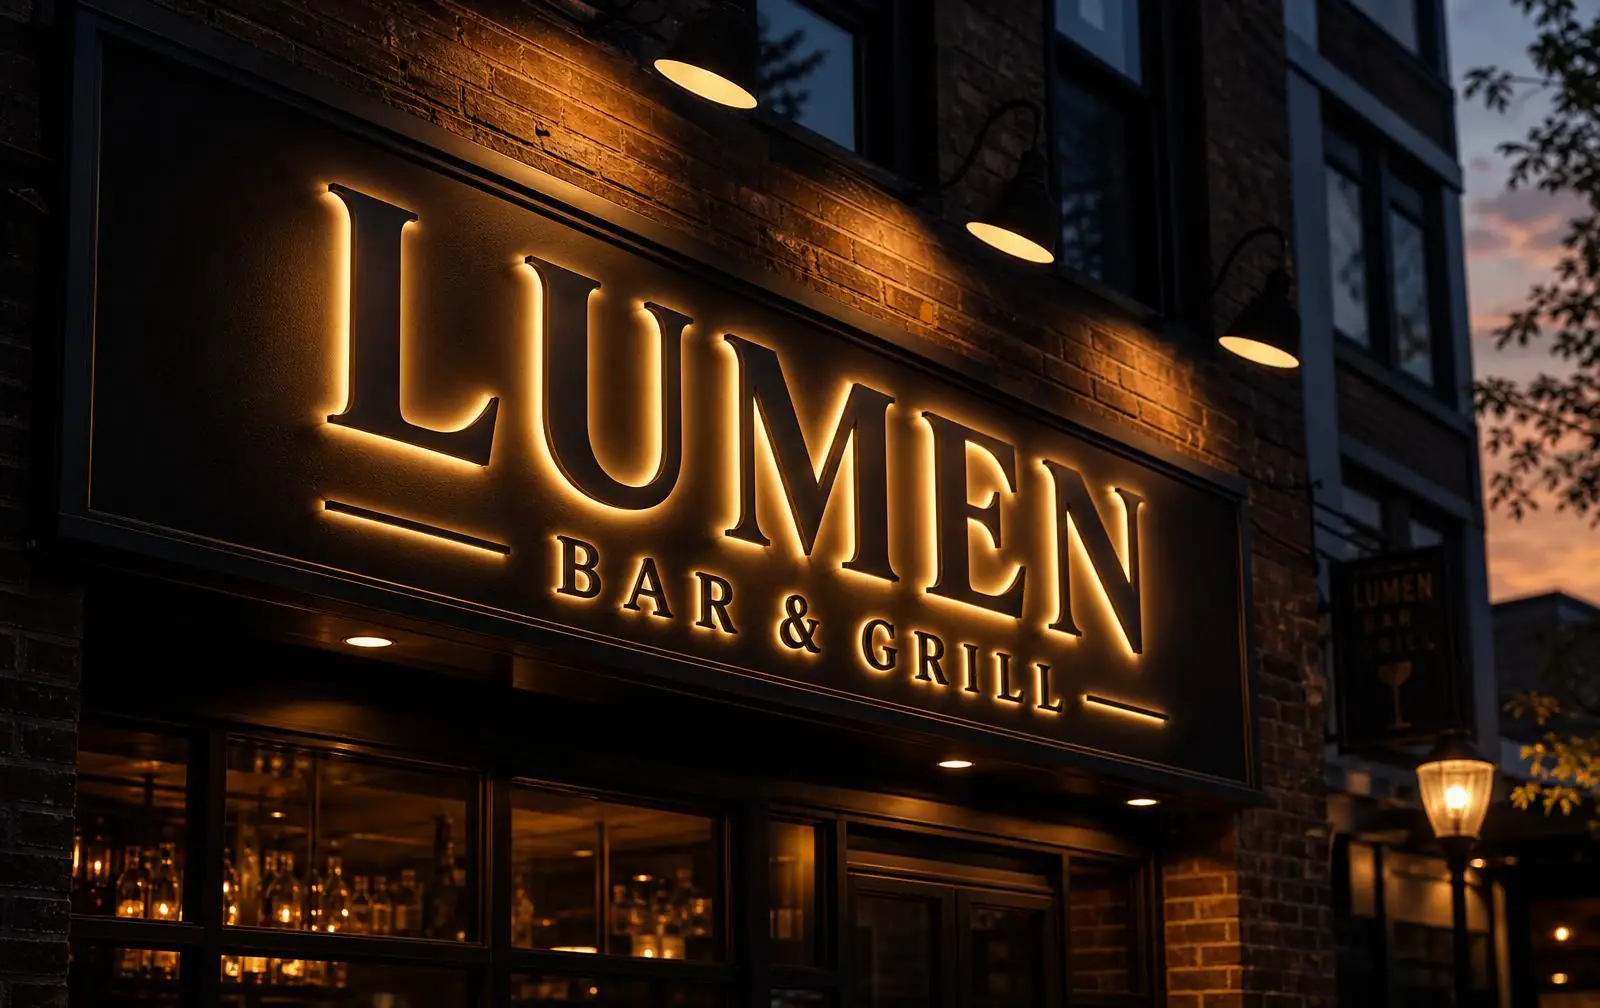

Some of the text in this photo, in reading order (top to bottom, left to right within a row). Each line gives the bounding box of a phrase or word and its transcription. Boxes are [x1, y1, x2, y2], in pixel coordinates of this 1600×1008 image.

[327, 183, 1147, 654] LUMEN
[556, 535, 1063, 713] BAR & GRILL
[1352, 570, 1433, 610] LUMEN
